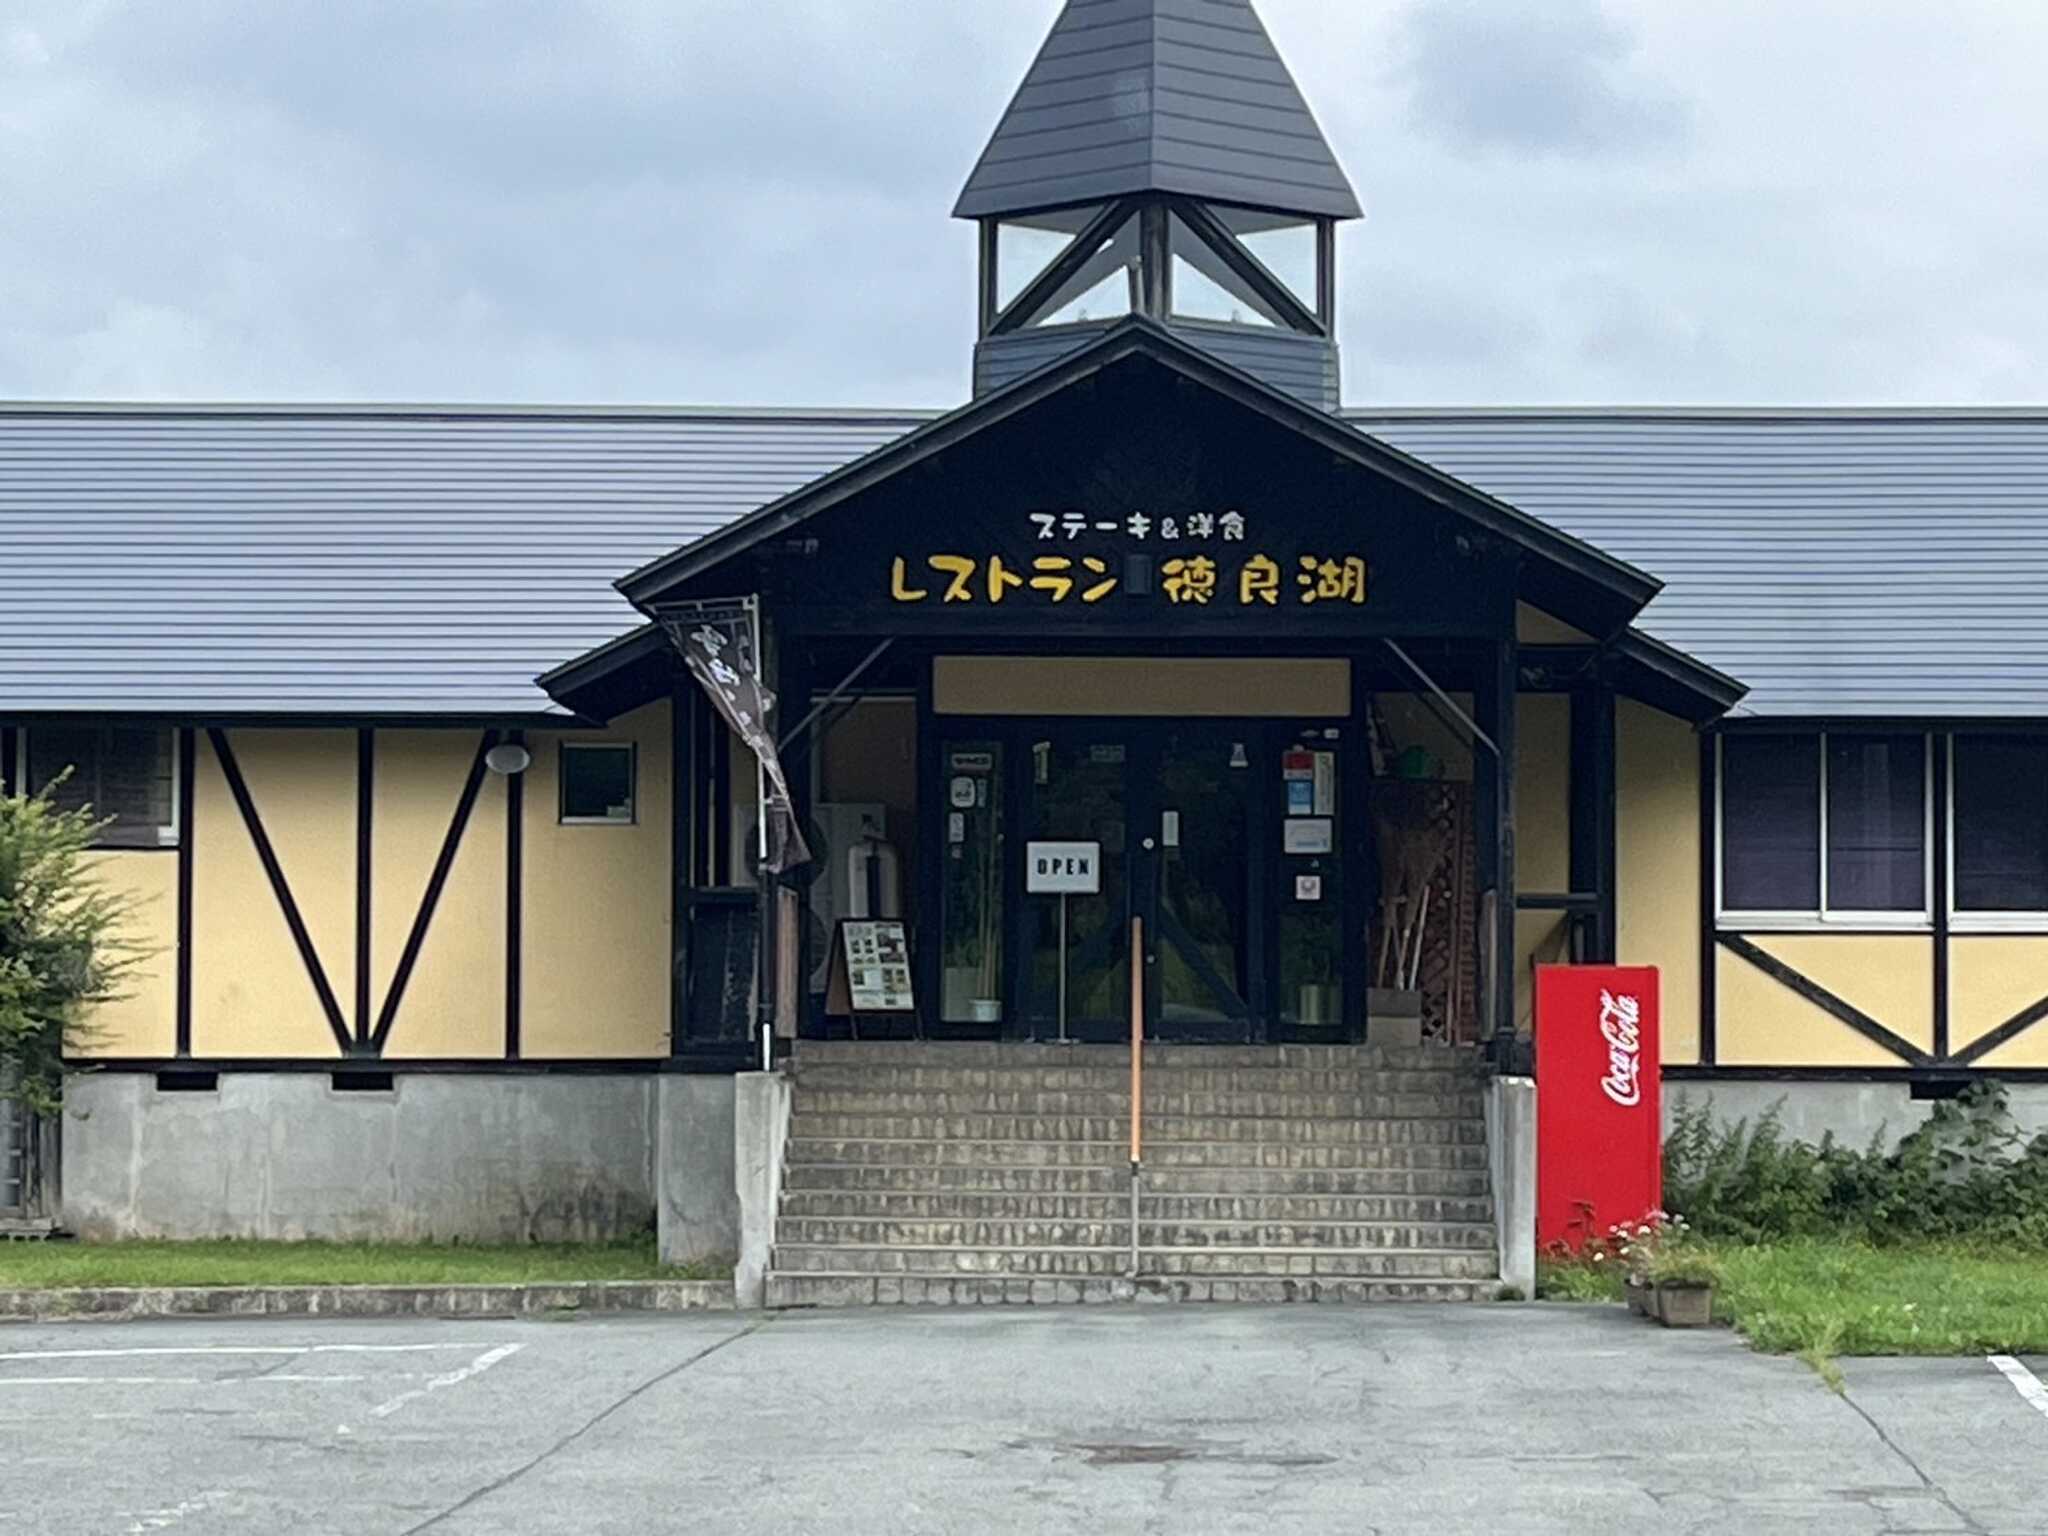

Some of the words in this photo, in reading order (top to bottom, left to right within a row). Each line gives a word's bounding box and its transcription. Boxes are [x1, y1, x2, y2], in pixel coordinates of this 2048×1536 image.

[891, 554, 1118, 602] レストラン
[1161, 554, 1367, 604] 徳良湖
[1037, 857, 1090, 875] OPEN
